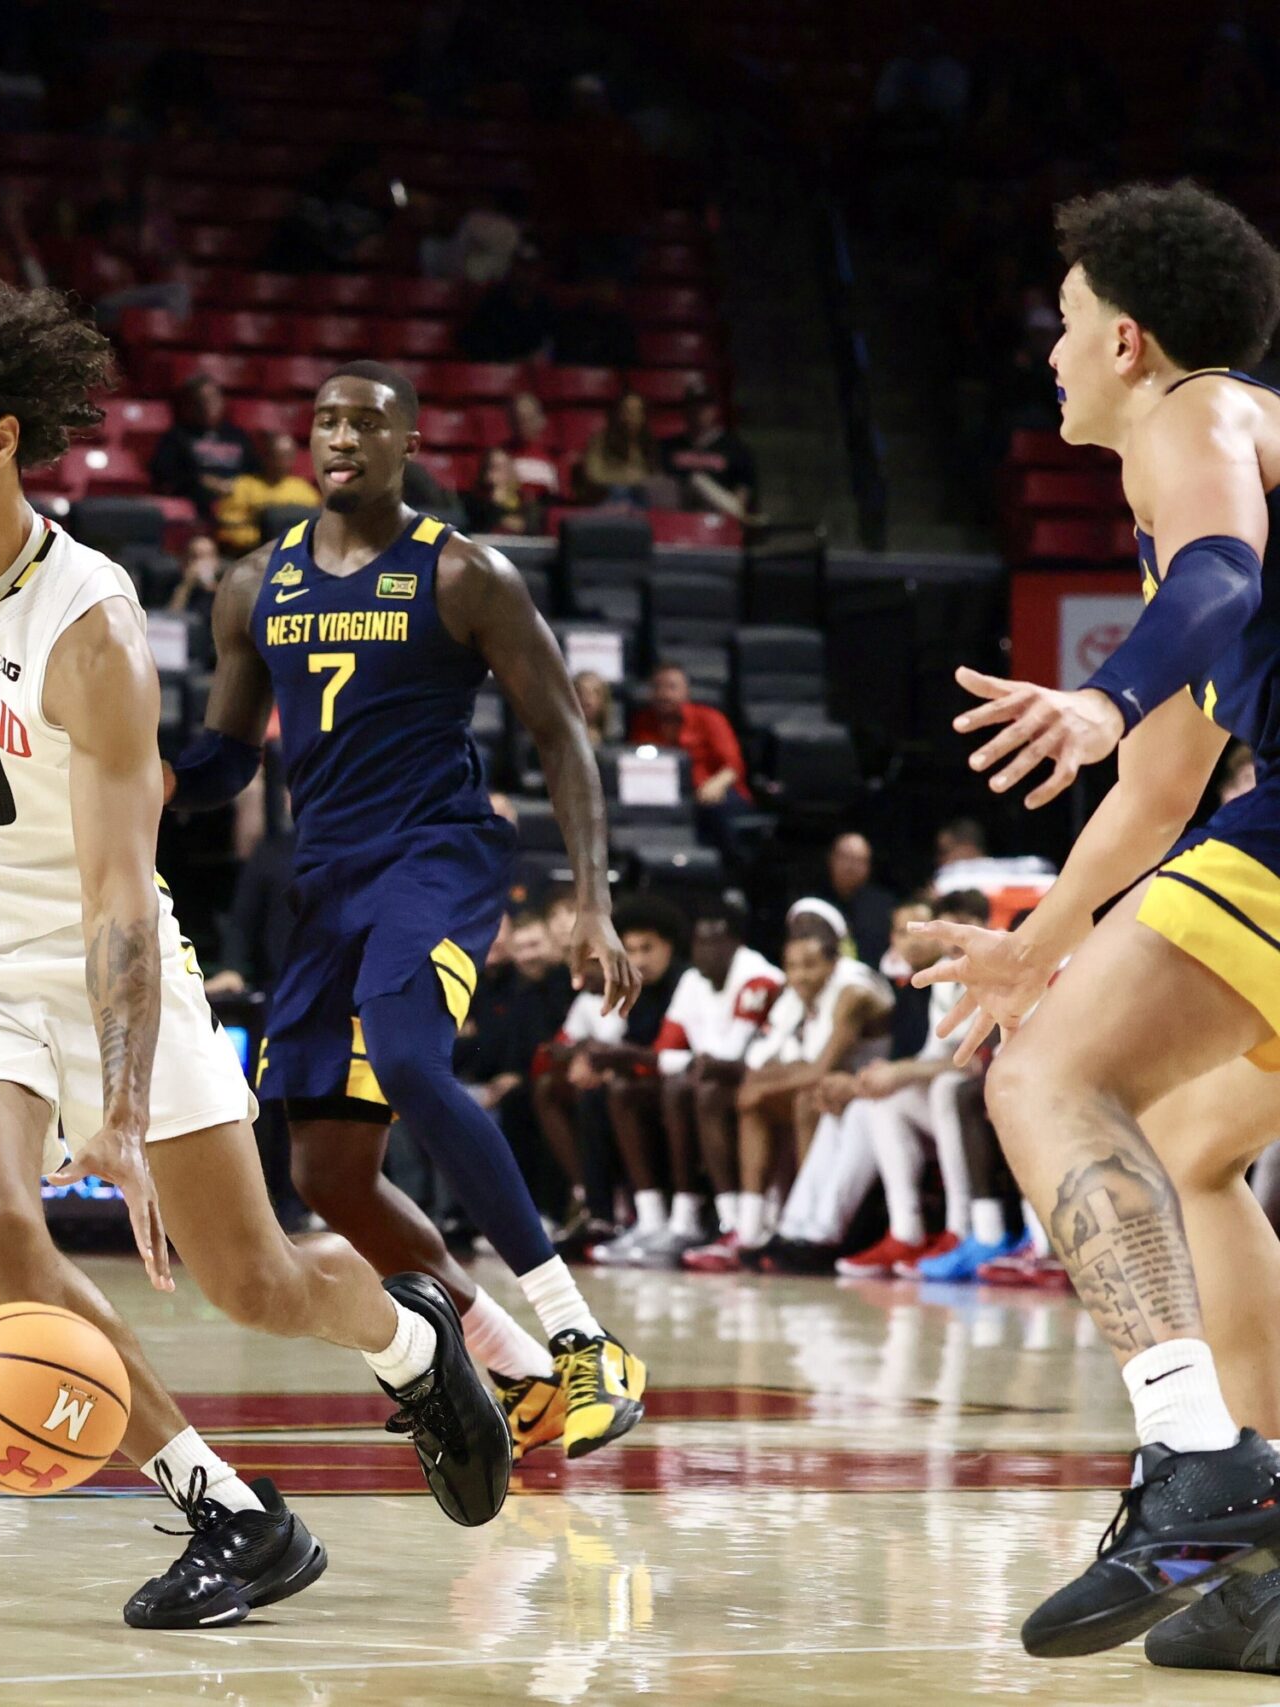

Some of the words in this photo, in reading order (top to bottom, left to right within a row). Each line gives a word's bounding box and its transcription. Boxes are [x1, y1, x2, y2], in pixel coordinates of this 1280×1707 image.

[267, 614, 314, 645] WEST
[318, 611, 408, 641] VIRGINIA
[308, 652, 356, 732] 7
